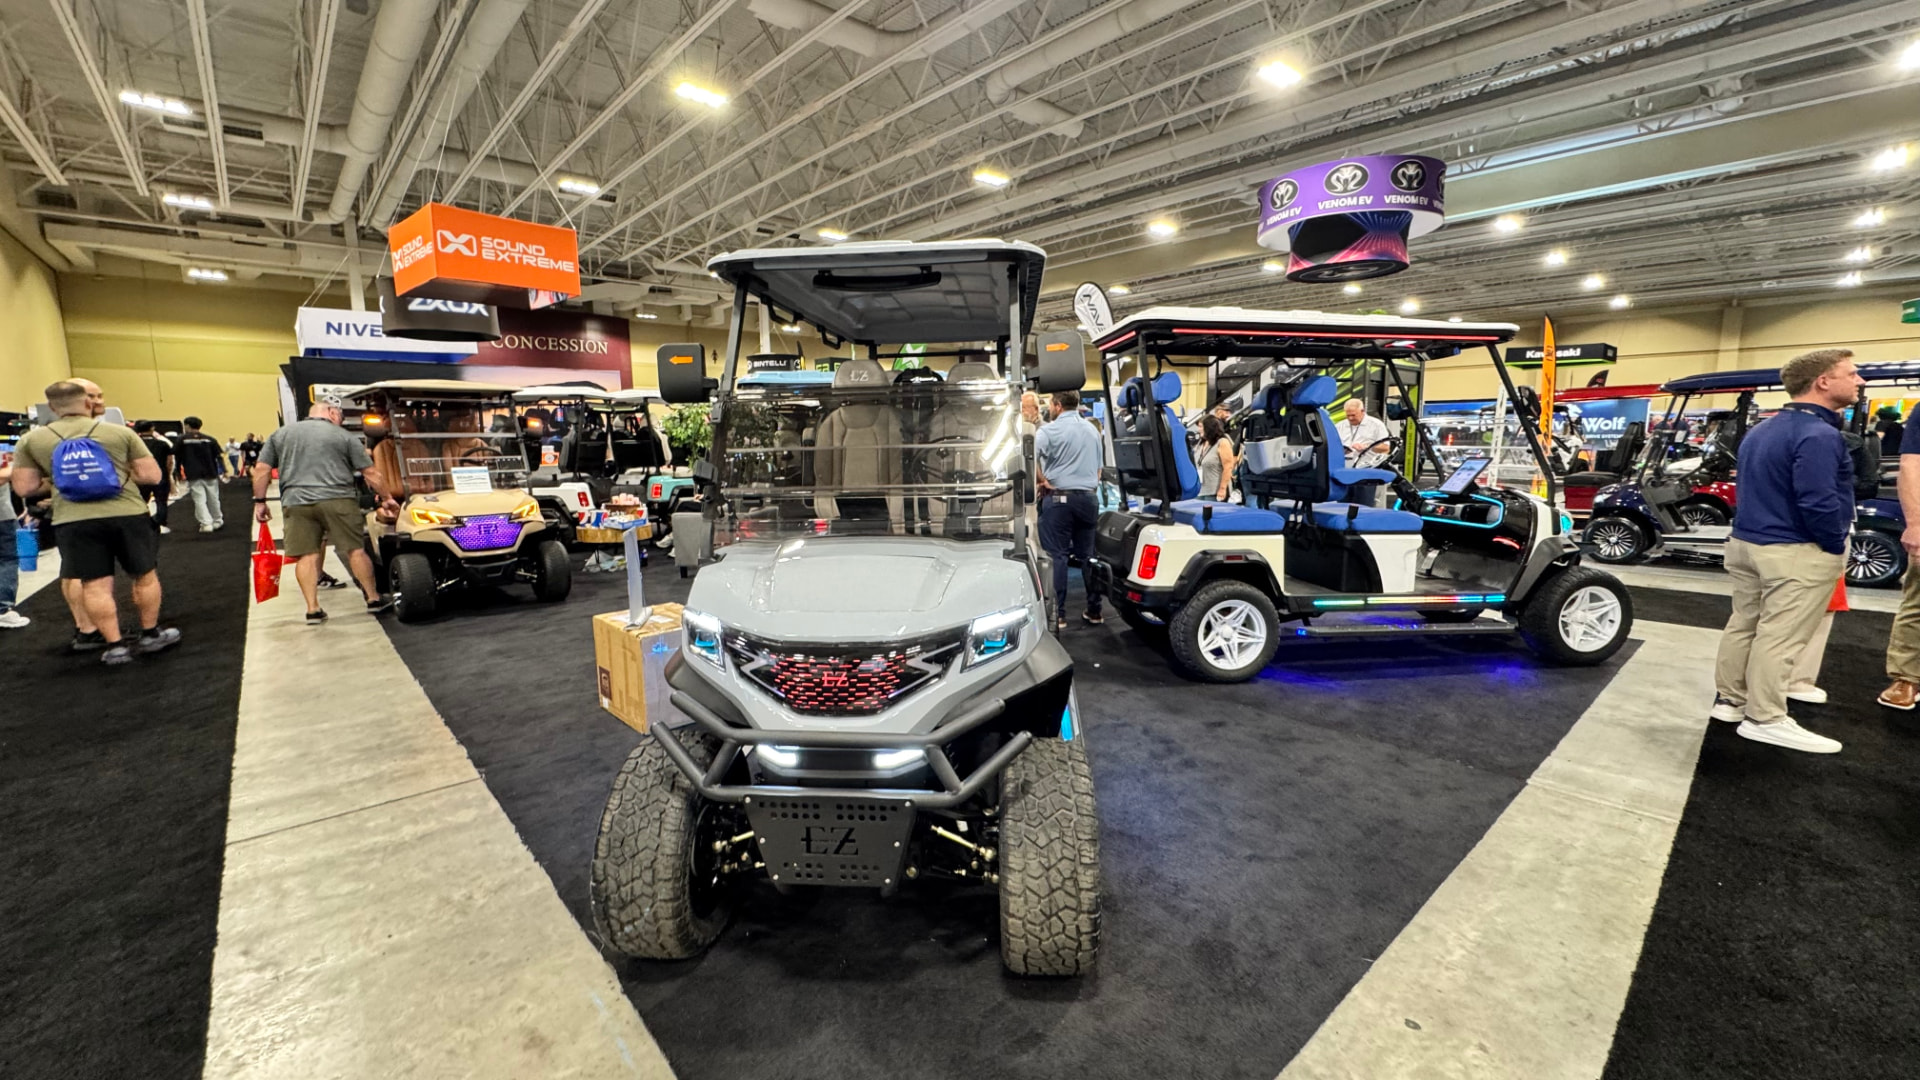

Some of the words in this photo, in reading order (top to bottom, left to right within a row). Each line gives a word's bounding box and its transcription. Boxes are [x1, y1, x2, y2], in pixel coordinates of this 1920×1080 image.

[1317, 196, 1357, 210] VENOM
[1358, 195, 1374, 206] EV
[1383, 194, 1419, 205] VENOM
[1419, 196, 1429, 206] EV
[1266, 209, 1289, 225] VENOM
[1289, 206, 1303, 217] EV
[402, 234, 423, 256] SOUND
[480, 236, 546, 257] SOUND
[403, 241, 433, 268] EXTREME
[482, 248, 575, 273] EXTREME
[326, 321, 384, 338] NIVE
[491, 334, 609, 355] CONCESSION
[1526, 347, 1581, 358] Kasaki
[753, 359, 787, 368] BINTELLI
[1582, 416, 1626, 432] Wolf
[822, 671, 849, 687] EZ
[801, 826, 859, 856] EZ
